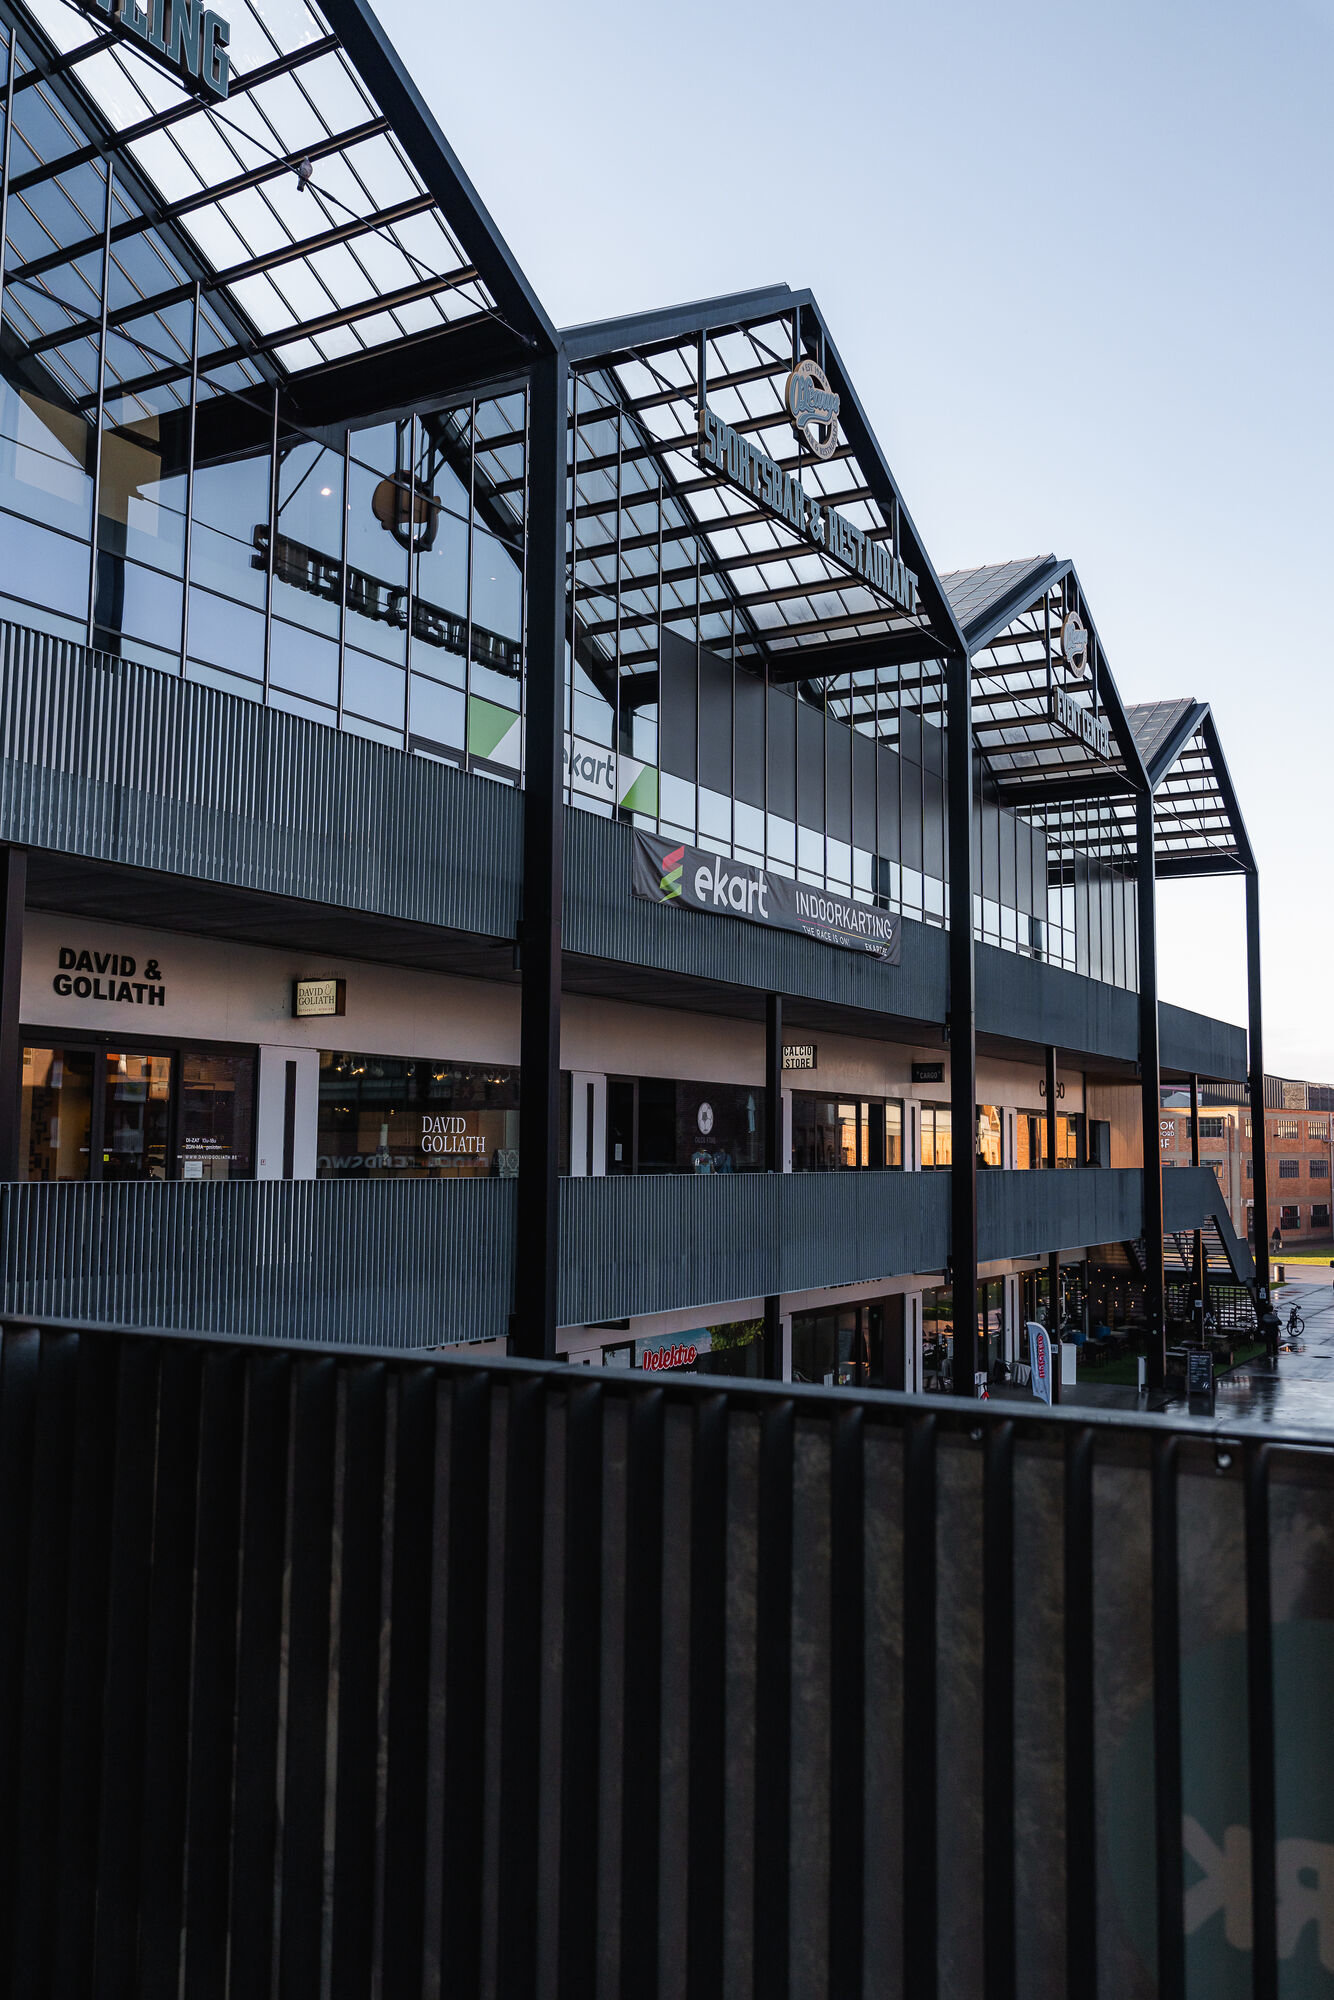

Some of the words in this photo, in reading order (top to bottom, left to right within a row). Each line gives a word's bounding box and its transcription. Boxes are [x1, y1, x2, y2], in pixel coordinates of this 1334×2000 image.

[704, 408, 807, 532] SPORTSBAR
[809, 500, 826, 545] &
[827, 506, 918, 615] RESTAURANT
[1057, 686, 1082, 738] EVENT
[1082, 708, 1110, 760] CENTER
[694, 856, 769, 919] ekart
[795, 890, 893, 940] INDOORKARTING
[802, 925, 815, 937] THE
[816, 929, 831, 941] RACE
[832, 933, 839, 943] IS
[59, 947, 136, 977] DAVID
[144, 959, 162, 980] &
[53, 974, 165, 1006] GOLIATH
[298, 987, 324, 997] DAVID
[298, 995, 335, 1005] GOLIATH
[784, 1046, 812, 1056] CALCIO
[785, 1058, 810, 1068] STORE
[1039, 1080, 1065, 1099] CGO
[421, 1115, 466, 1134] DAVID
[421, 1135, 486, 1153] GOLIATH
[643, 1344, 697, 1371] Velektro
